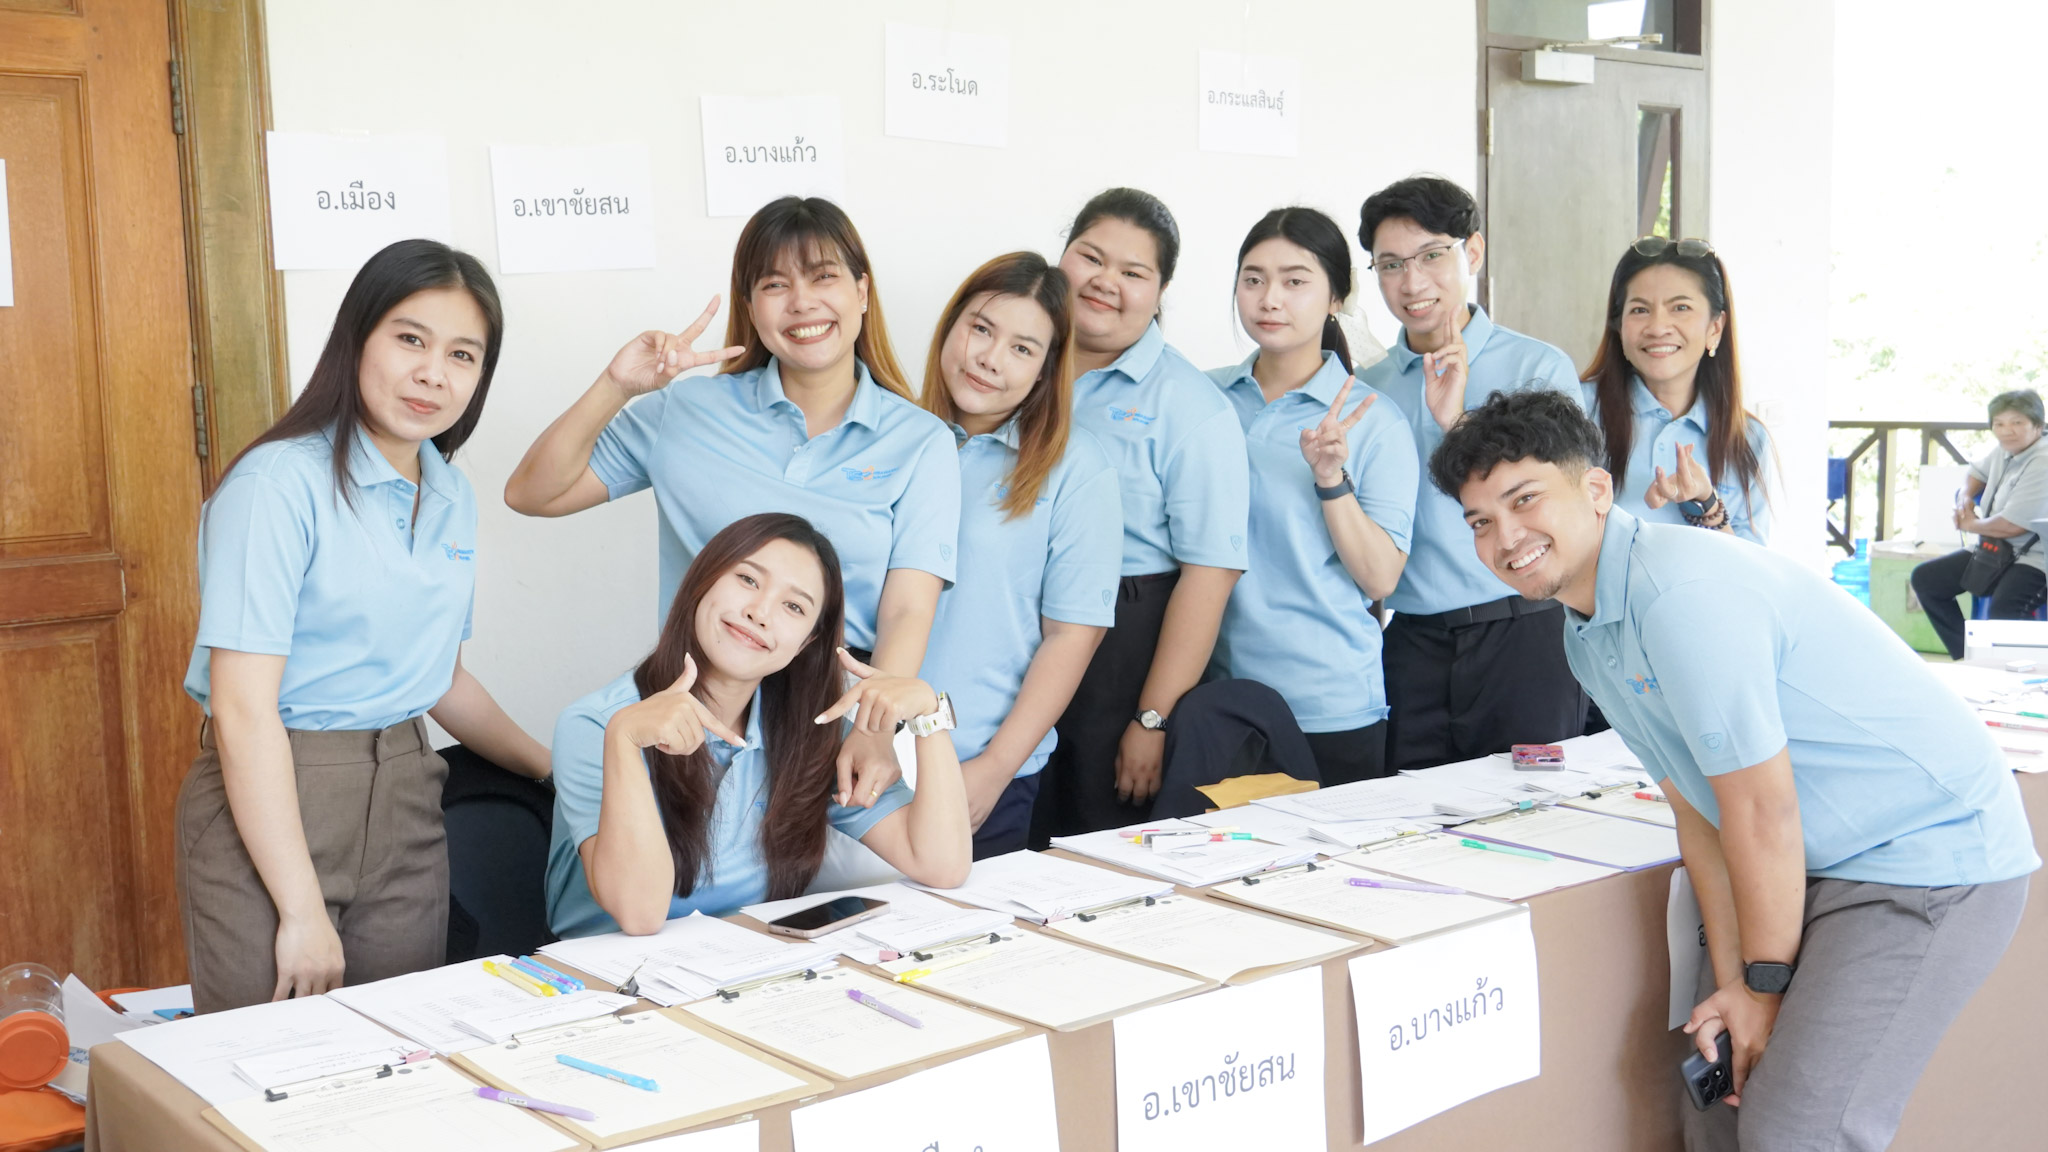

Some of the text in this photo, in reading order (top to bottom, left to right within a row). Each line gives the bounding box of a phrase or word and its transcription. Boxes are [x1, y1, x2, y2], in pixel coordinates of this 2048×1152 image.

[911, 67, 978, 97] อ.ระโนด
[1207, 89, 1285, 117] อ.กระแสสินธุ์
[725, 135, 817, 164] อ.บางแก้ว
[316, 180, 396, 211] อ.เมือง
[513, 187, 630, 217] อ.เขาชัยสน
[1389, 976, 1504, 1051] อ.บางแก้ว
[1142, 1051, 1295, 1121] อ.เขาชัยสน
